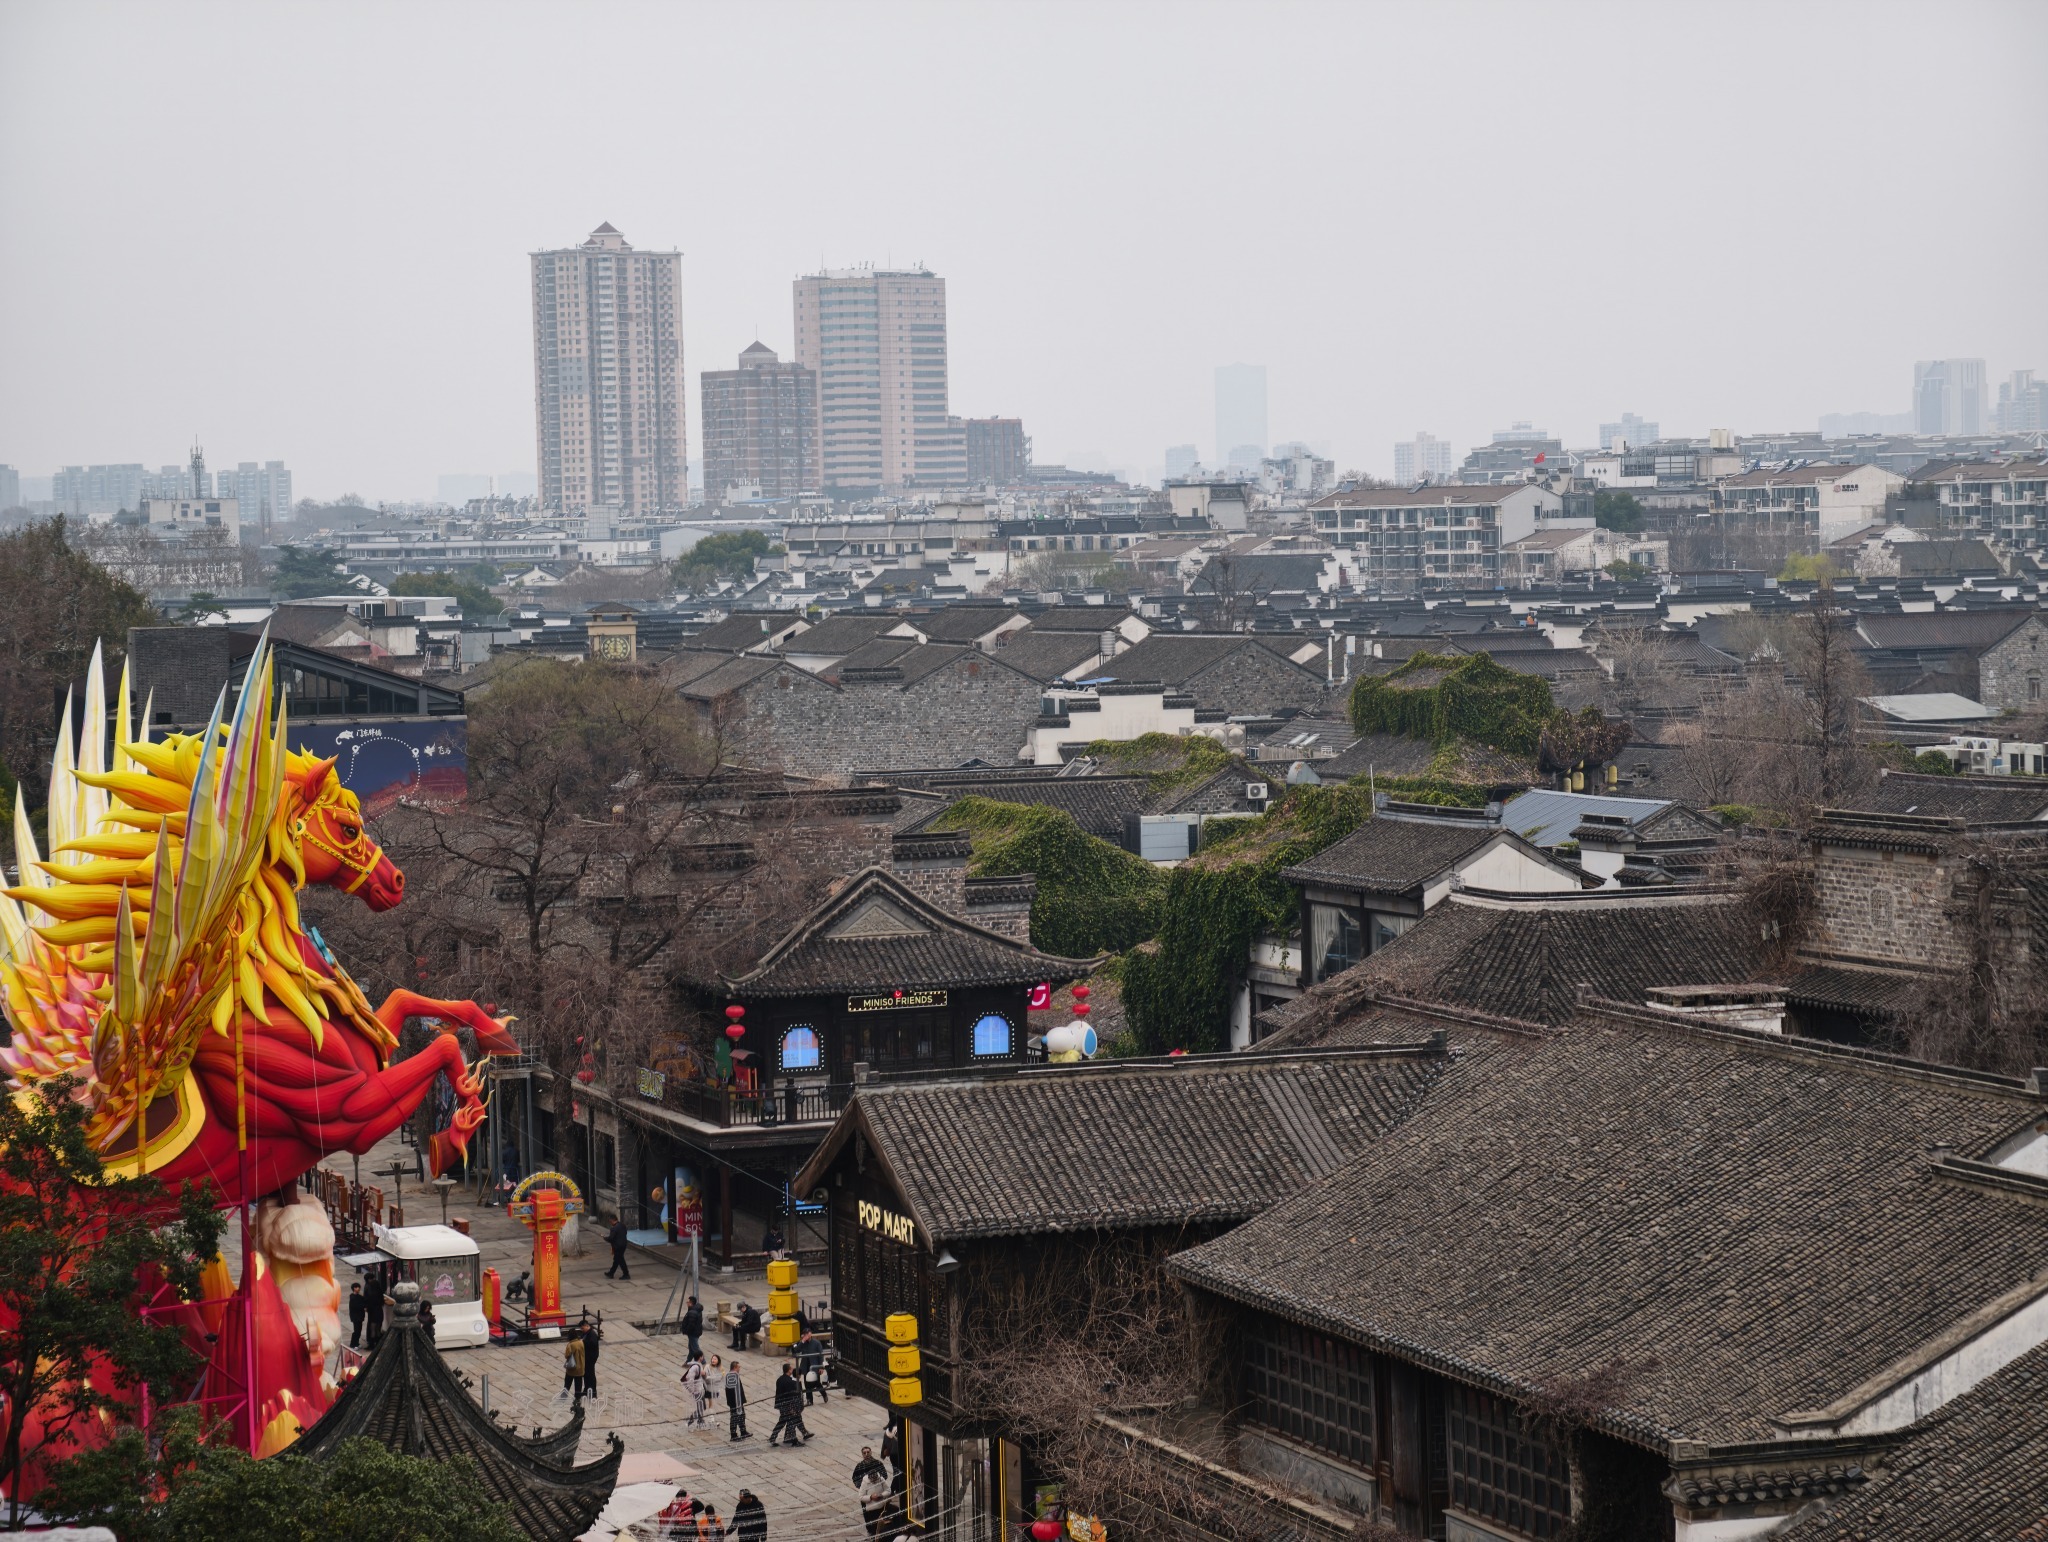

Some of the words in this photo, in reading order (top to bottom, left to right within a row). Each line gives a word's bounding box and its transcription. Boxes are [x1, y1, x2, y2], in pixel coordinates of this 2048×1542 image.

[863, 998, 893, 1007] MINISO
[896, 995, 933, 1005] FRIENDS
[685, 1212, 702, 1222] MIN
[858, 1200, 881, 1230] POP
[883, 1209, 915, 1245] MART
